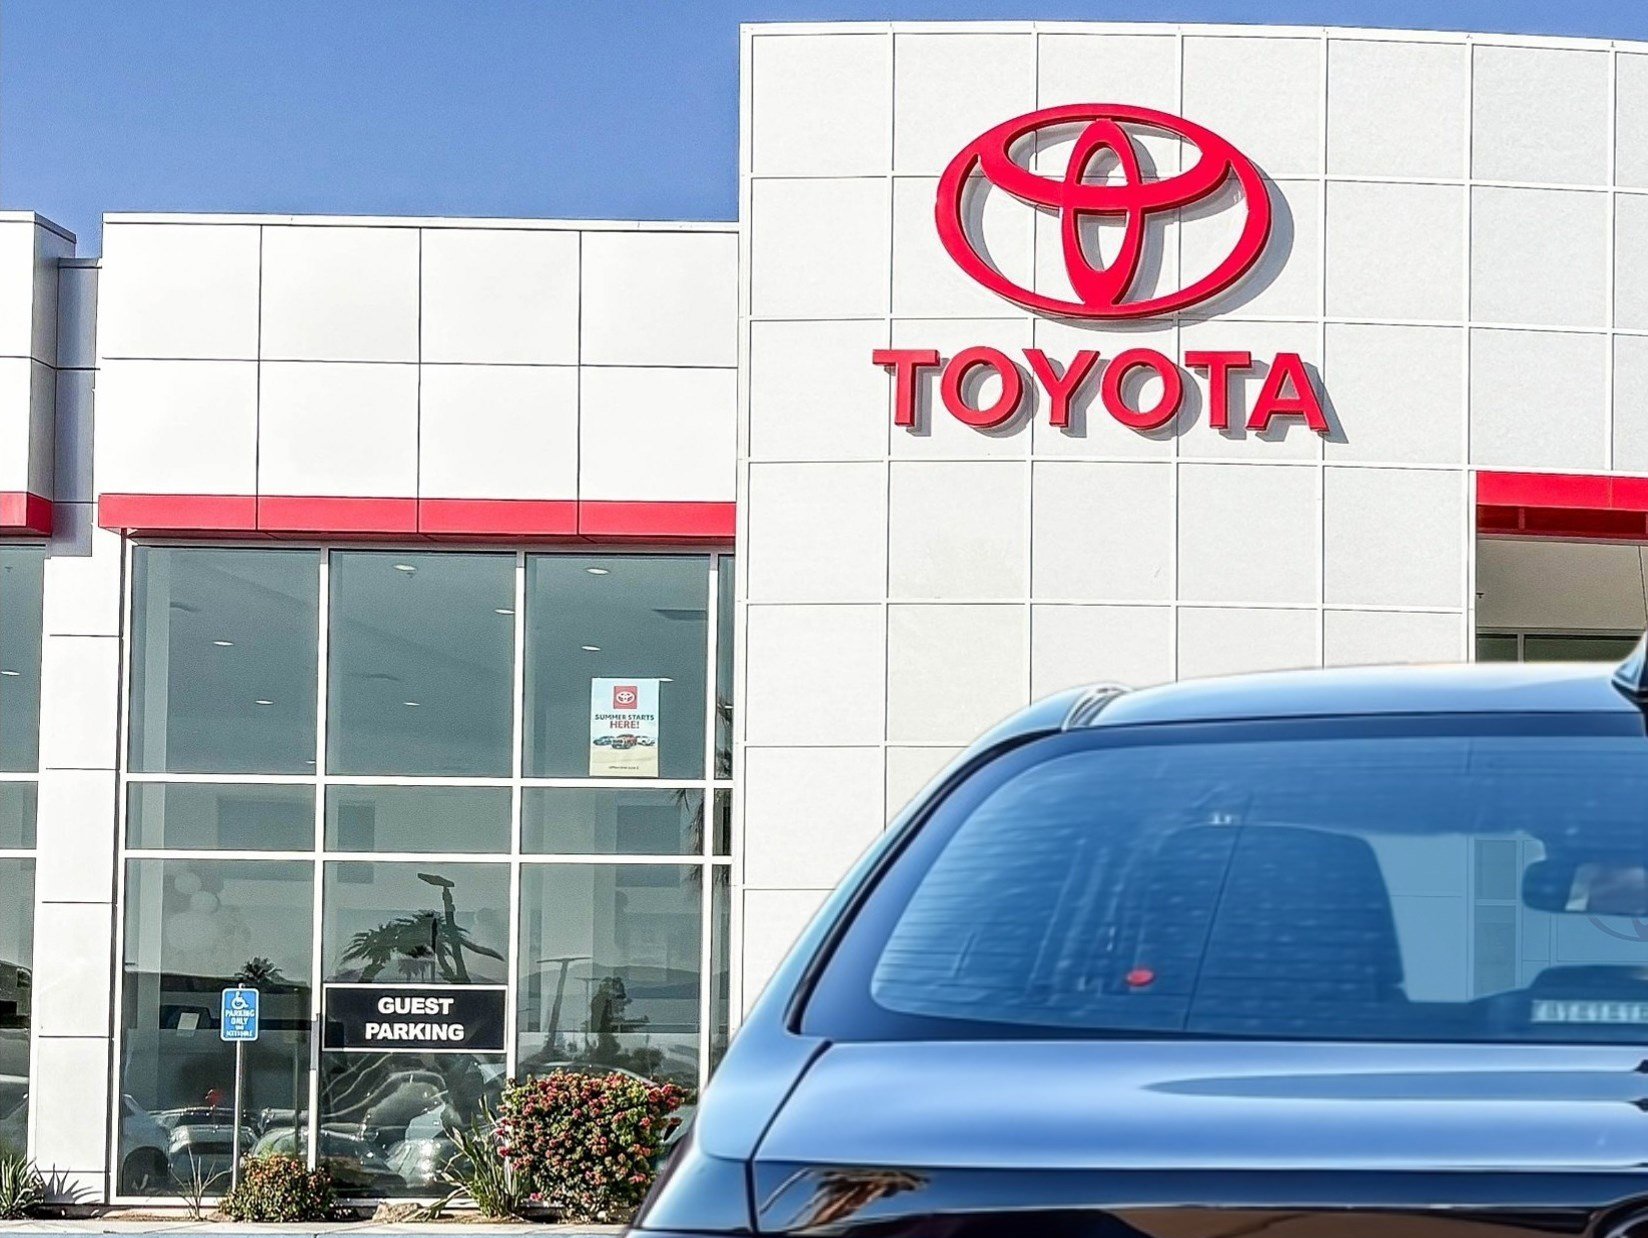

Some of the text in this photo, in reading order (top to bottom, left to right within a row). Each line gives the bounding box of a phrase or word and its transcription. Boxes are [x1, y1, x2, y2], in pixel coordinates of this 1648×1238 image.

[873, 346, 1329, 431] TOYOTA
[609, 720, 640, 729] HERE!
[377, 997, 454, 1015] GUEST
[365, 1023, 465, 1041] PARKING
